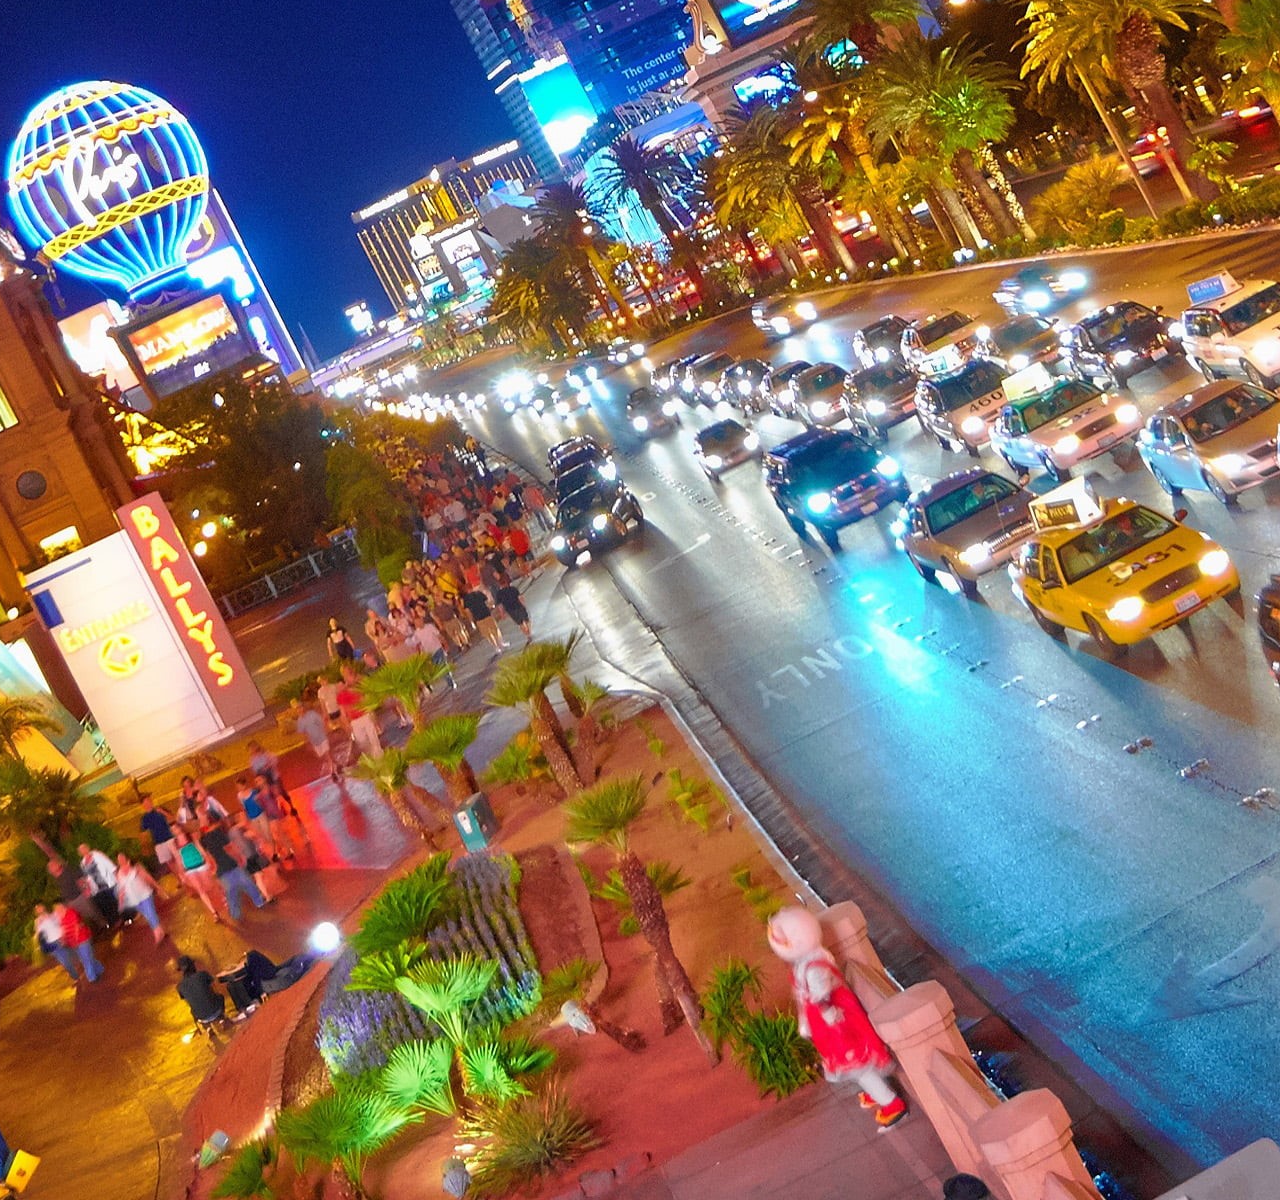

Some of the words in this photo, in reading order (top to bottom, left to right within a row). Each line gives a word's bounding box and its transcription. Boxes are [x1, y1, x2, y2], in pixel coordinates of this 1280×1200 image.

[621, 66, 644, 80] The
[644, 49, 676, 70] center
[625, 83, 638, 95] is
[637, 73, 659, 94] just
[57, 600, 153, 654] ENTRANCE
[754, 634, 875, 708] ONLY
